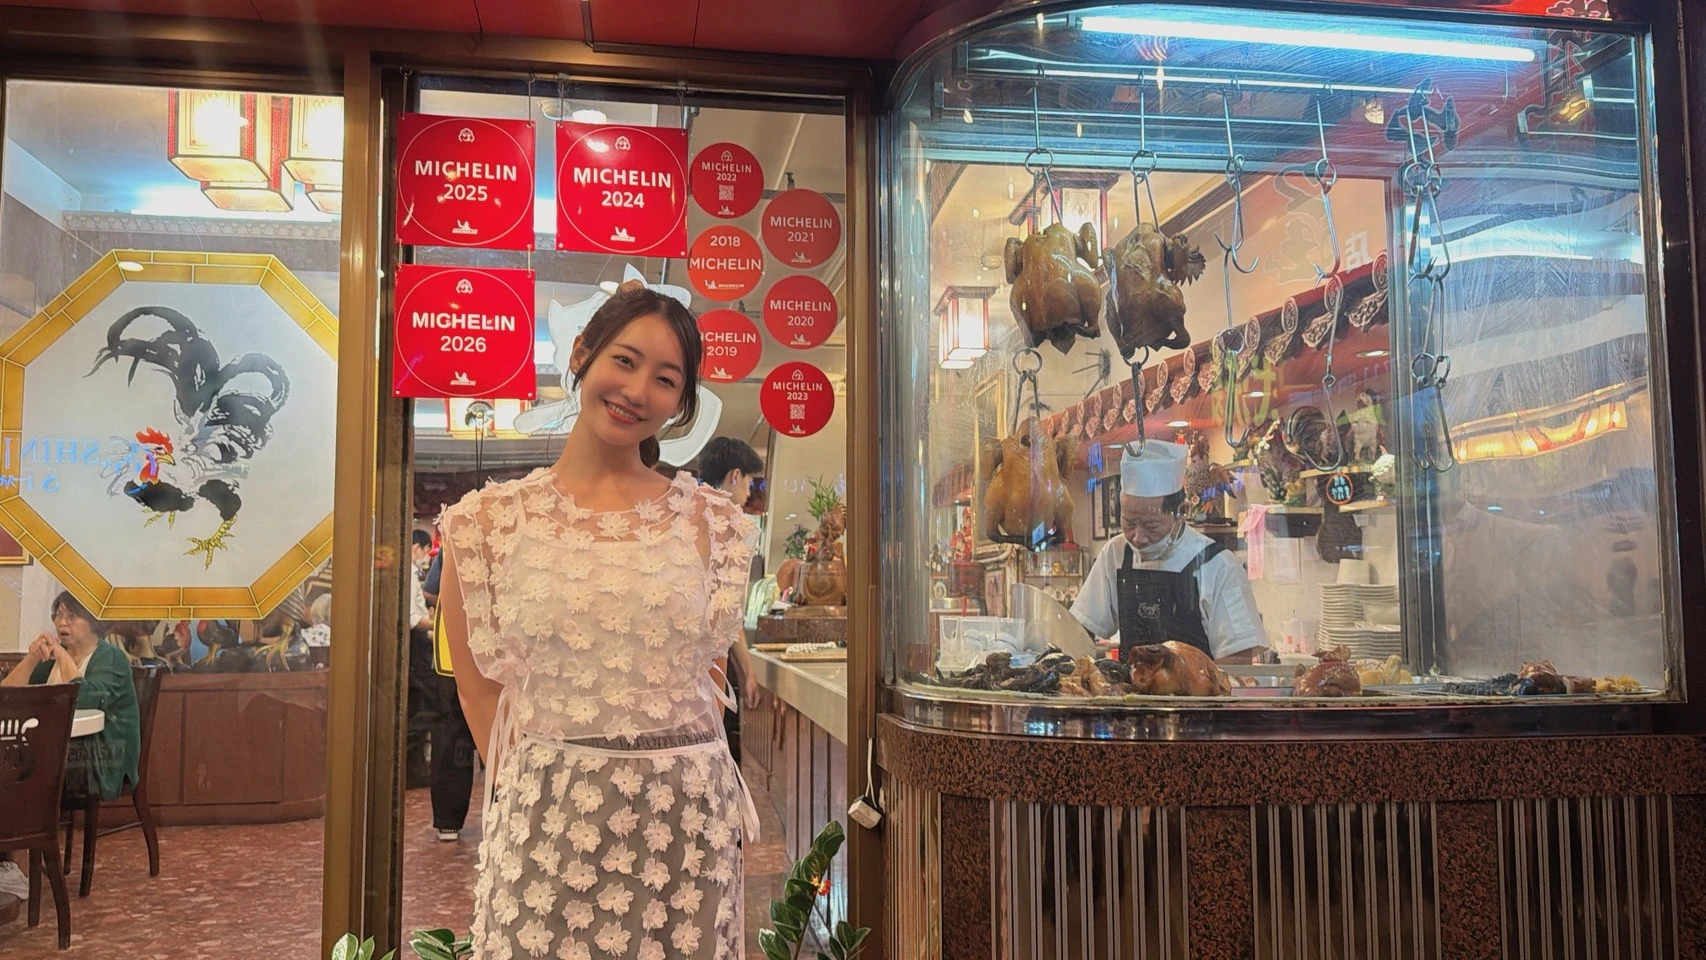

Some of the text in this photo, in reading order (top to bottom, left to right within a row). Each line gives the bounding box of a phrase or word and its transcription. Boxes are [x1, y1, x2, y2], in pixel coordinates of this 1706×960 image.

[414, 159, 518, 181] MICHELIN
[701, 161, 752, 174] MICHELIN
[573, 166, 671, 189] MICHELIN
[716, 173, 737, 182] 2022
[443, 183, 489, 202] 2025
[601, 190, 645, 208] 2024
[769, 215, 833, 230] MICHELIN
[709, 235, 741, 248] 2018
[787, 231, 815, 243] 2021
[689, 257, 762, 271] MICHELIN
[769, 300, 832, 312] MICHELIN
[412, 311, 516, 332] MICHELIN
[787, 315, 815, 327] 2020
[440, 335, 487, 353] 2026
[700, 331, 757, 344] ICHELIN
[706, 345, 738, 357] 2019
[772, 381, 823, 392] MICHELIN
[786, 391, 808, 401] 2023
